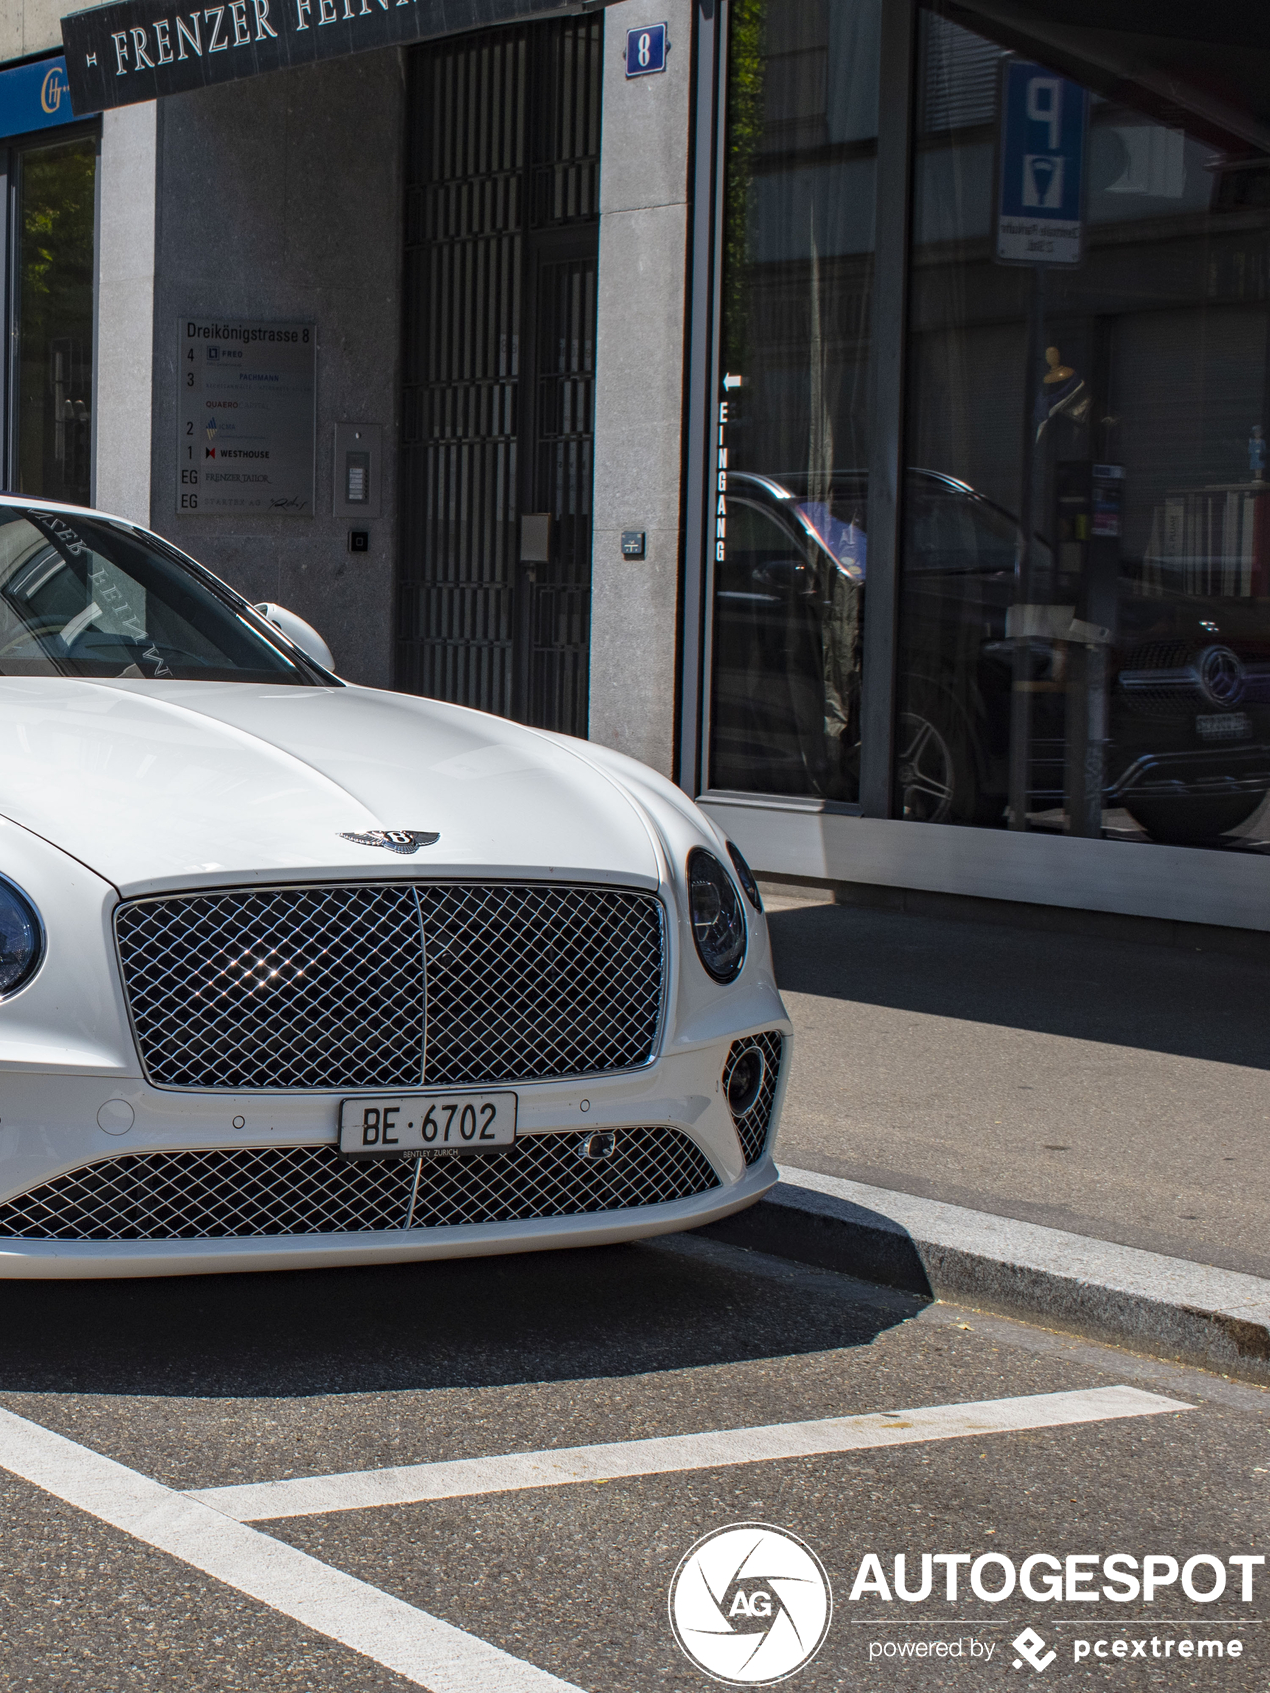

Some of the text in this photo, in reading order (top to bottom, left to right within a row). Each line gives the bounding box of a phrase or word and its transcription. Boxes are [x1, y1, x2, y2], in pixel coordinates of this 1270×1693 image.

[112, 0, 278, 75] FRENZER
[638, 33, 650, 67] 8
[187, 322, 310, 344] Dreikönigstrasse 8
[187, 348, 243, 361] 4 FREO
[187, 372, 280, 387] 3 PACHMANN
[206, 401, 238, 409] QUAERO
[186, 421, 194, 435] 2
[187, 446, 270, 459] 1 WESTHOUSE
[181, 469, 273, 484] EG FRENZER TAILOR
[715, 401, 729, 562] EINGANG
[181, 494, 198, 509] EG
[403, 1149, 458, 1158] BENTLEY ZURICH
